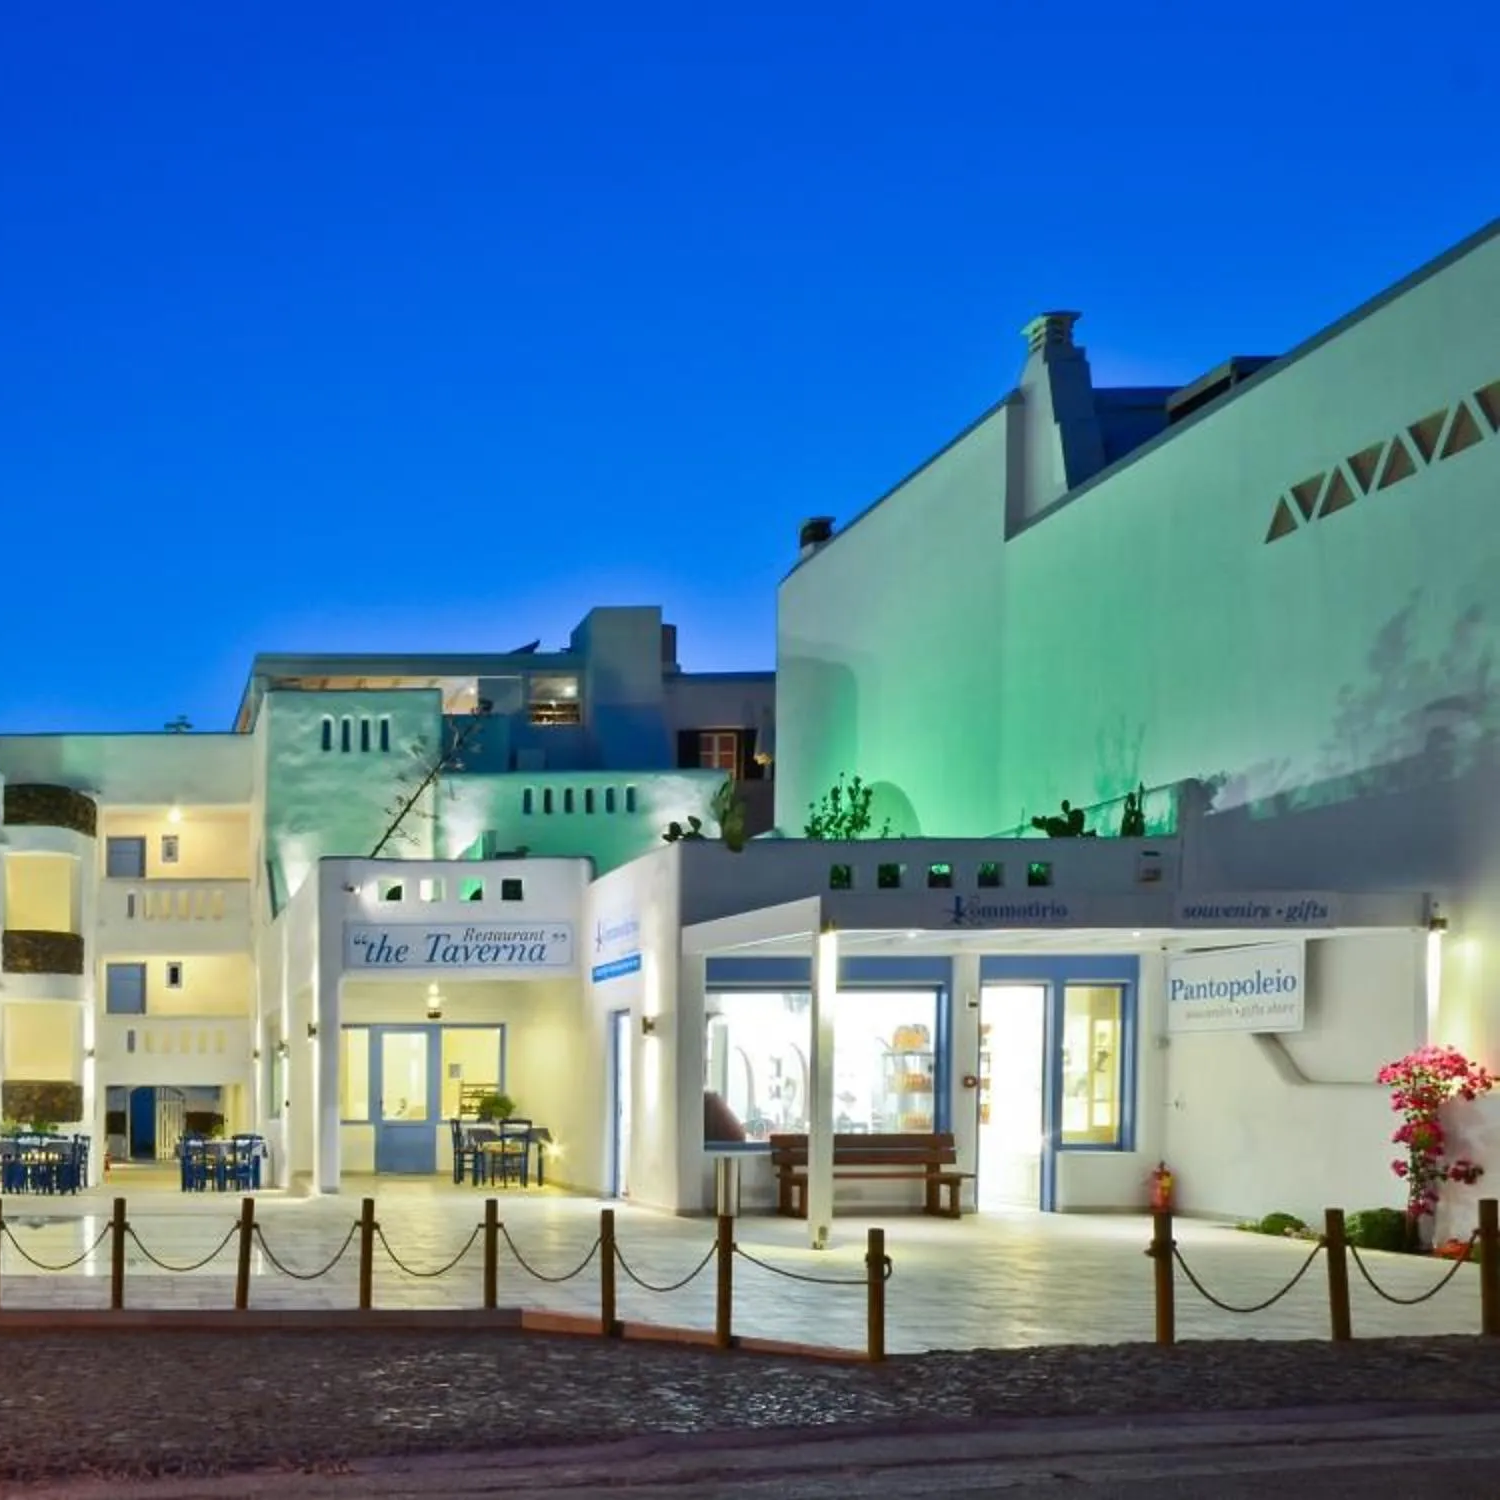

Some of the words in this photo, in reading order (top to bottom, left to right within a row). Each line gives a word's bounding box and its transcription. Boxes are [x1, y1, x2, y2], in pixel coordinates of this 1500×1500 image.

[1182, 902, 1272, 919] souvenirs
[1283, 900, 1330, 923] gifts
[462, 927, 546, 942] Restaurant
[1170, 967, 1298, 1002] Pantopoleio
